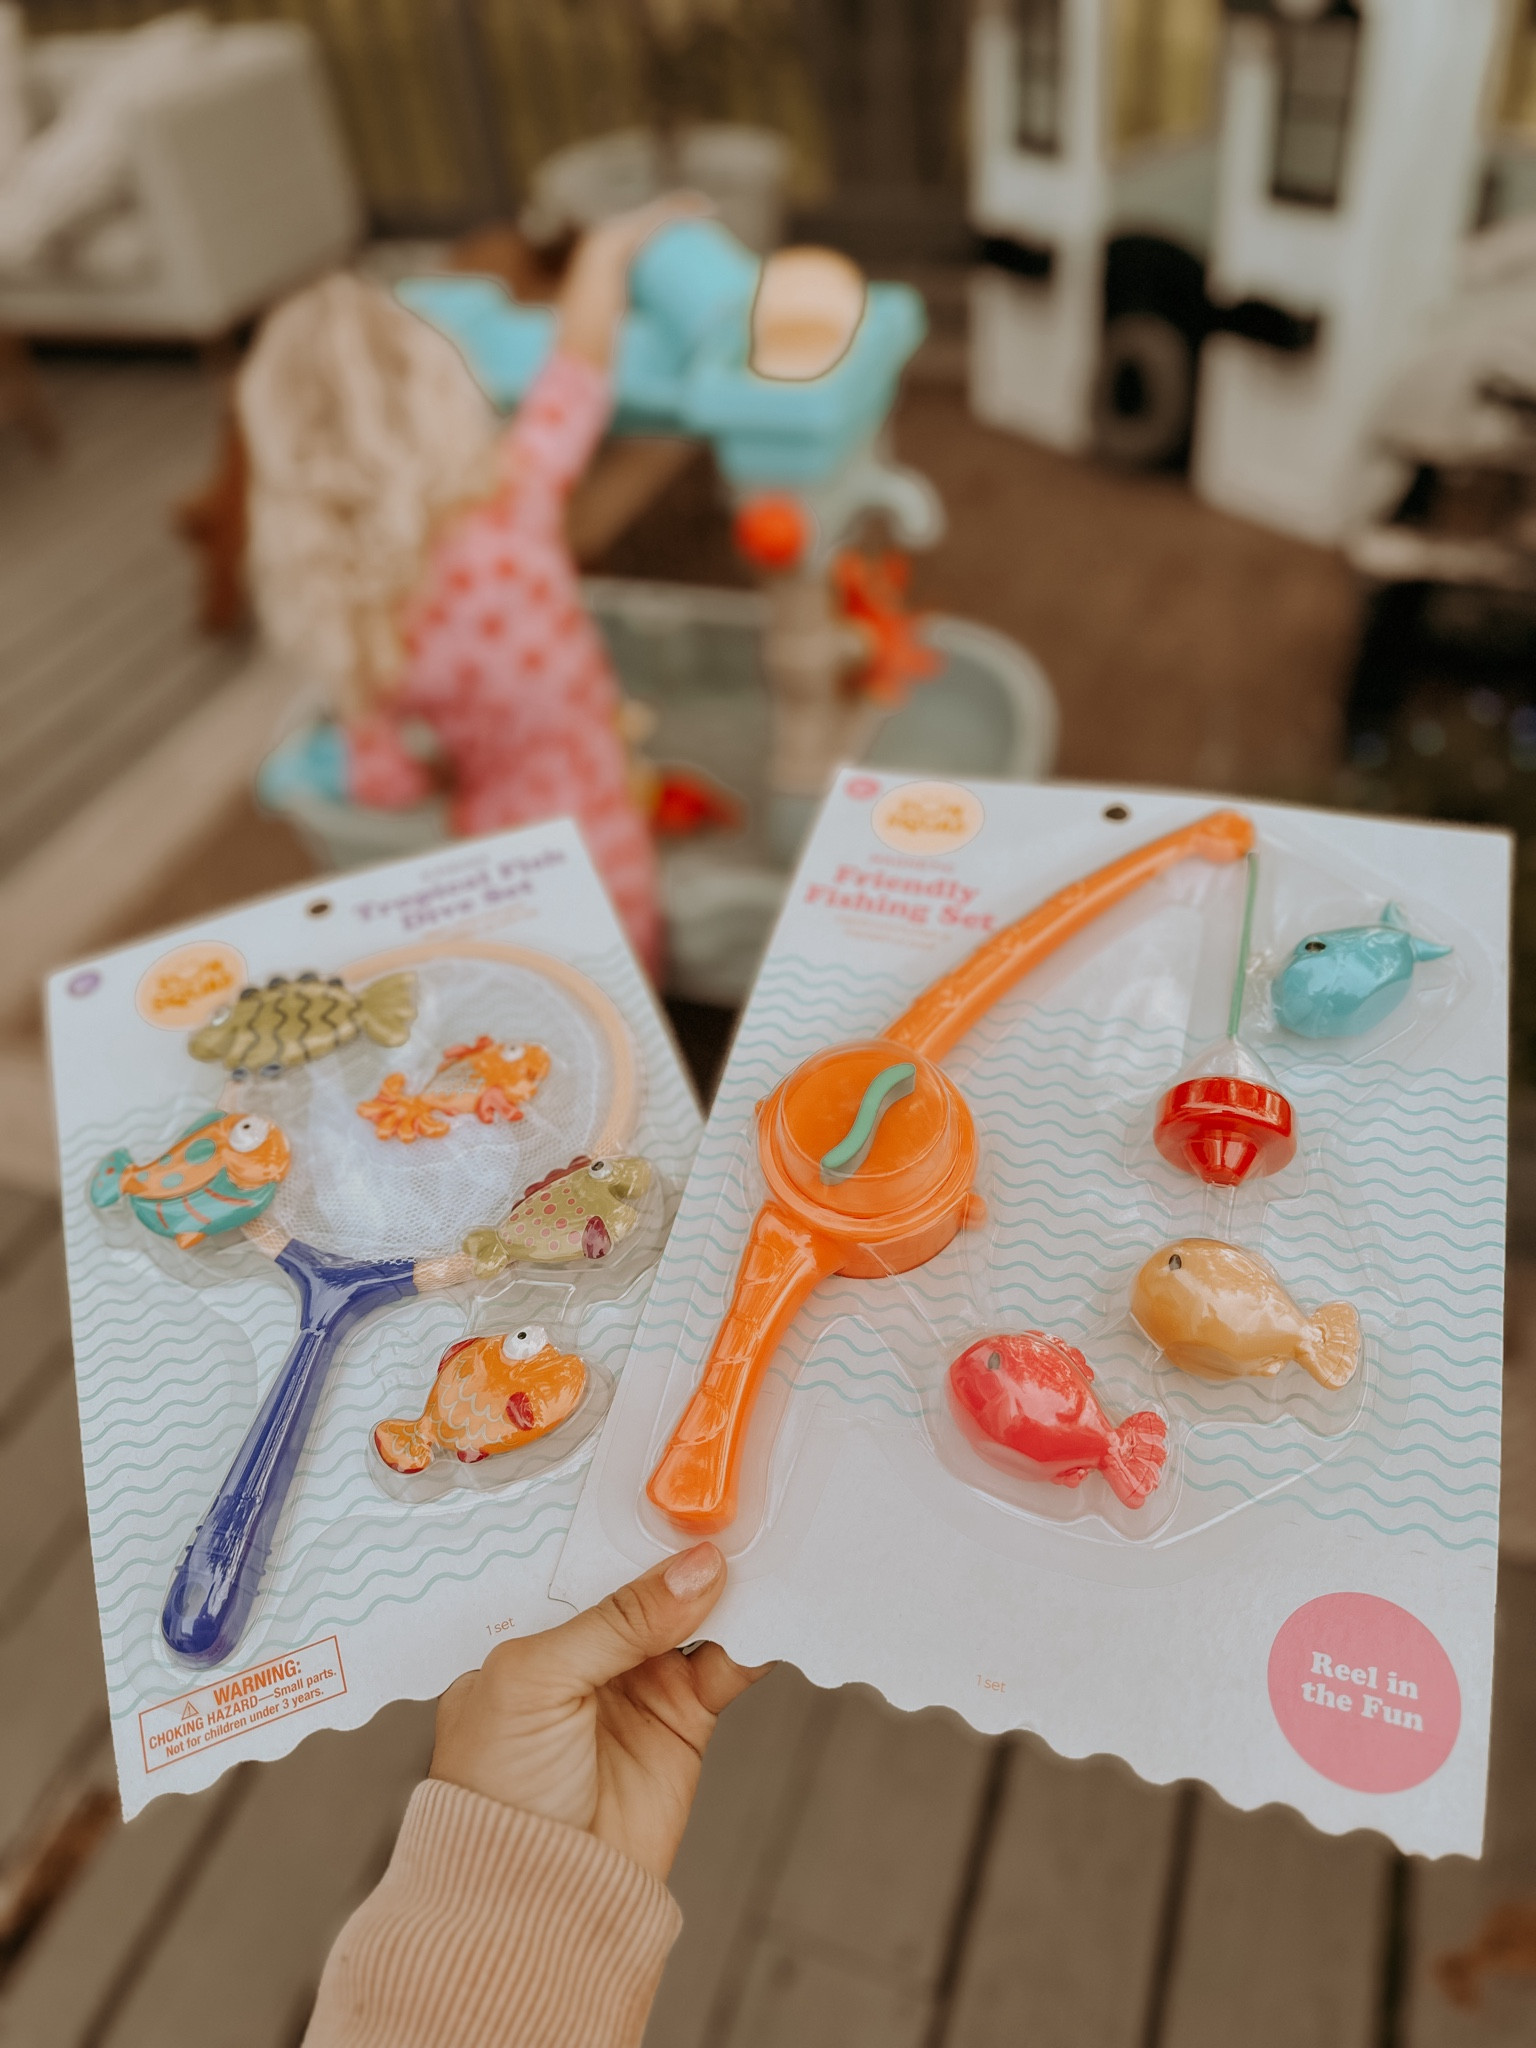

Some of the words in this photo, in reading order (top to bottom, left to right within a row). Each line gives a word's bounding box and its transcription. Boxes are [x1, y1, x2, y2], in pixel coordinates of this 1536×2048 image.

[484, 878, 534, 905] Set
[804, 882, 929, 924] Fishing
[937, 902, 999, 932] Set
[834, 864, 980, 906] Friendly
[494, 1617, 515, 1633] set
[213, 1659, 302, 1705] WARNING:
[984, 1679, 1006, 1693] set
[1310, 1651, 1379, 1689] Reel
[1386, 1671, 1419, 1700] in
[149, 1717, 204, 1749] CHOKING
[306, 1667, 337, 1689] parts.
[165, 1743, 185, 1758] Not
[187, 1735, 202, 1748] for
[204, 1718, 247, 1742] children
[249, 1702, 280, 1723] under
[282, 1698, 290, 1709] 3
[291, 1687, 324, 1708] years.
[1301, 1682, 1353, 1712] the
[1360, 1694, 1424, 1733] Fun
